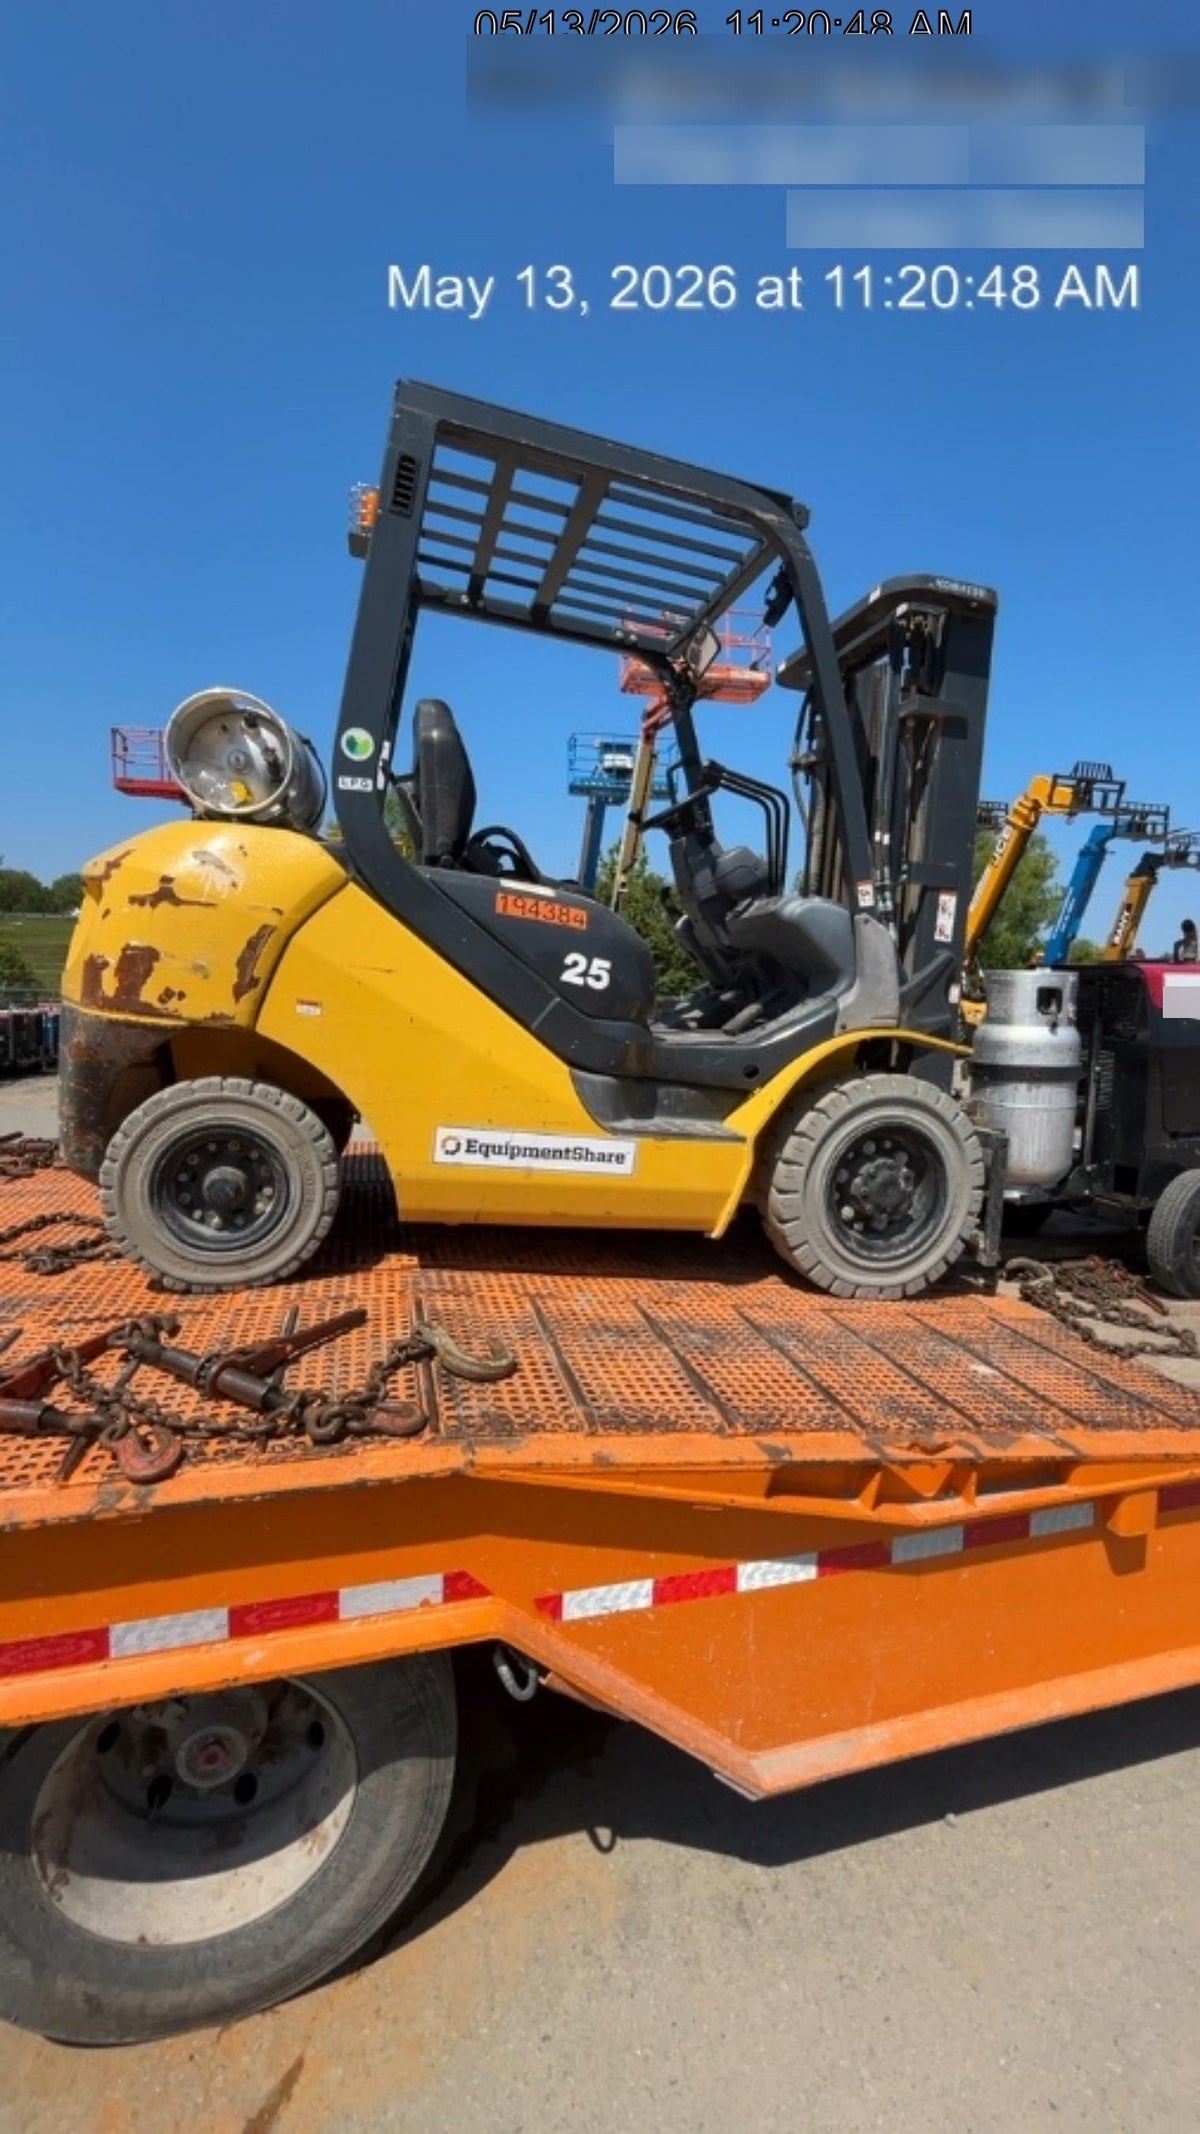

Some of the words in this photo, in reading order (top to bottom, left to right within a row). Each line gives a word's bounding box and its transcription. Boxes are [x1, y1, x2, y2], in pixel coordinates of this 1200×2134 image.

[499, 894, 585, 926] 194384
[560, 952, 612, 990] 25
[465, 1138, 627, 1165] EquipmentShare
